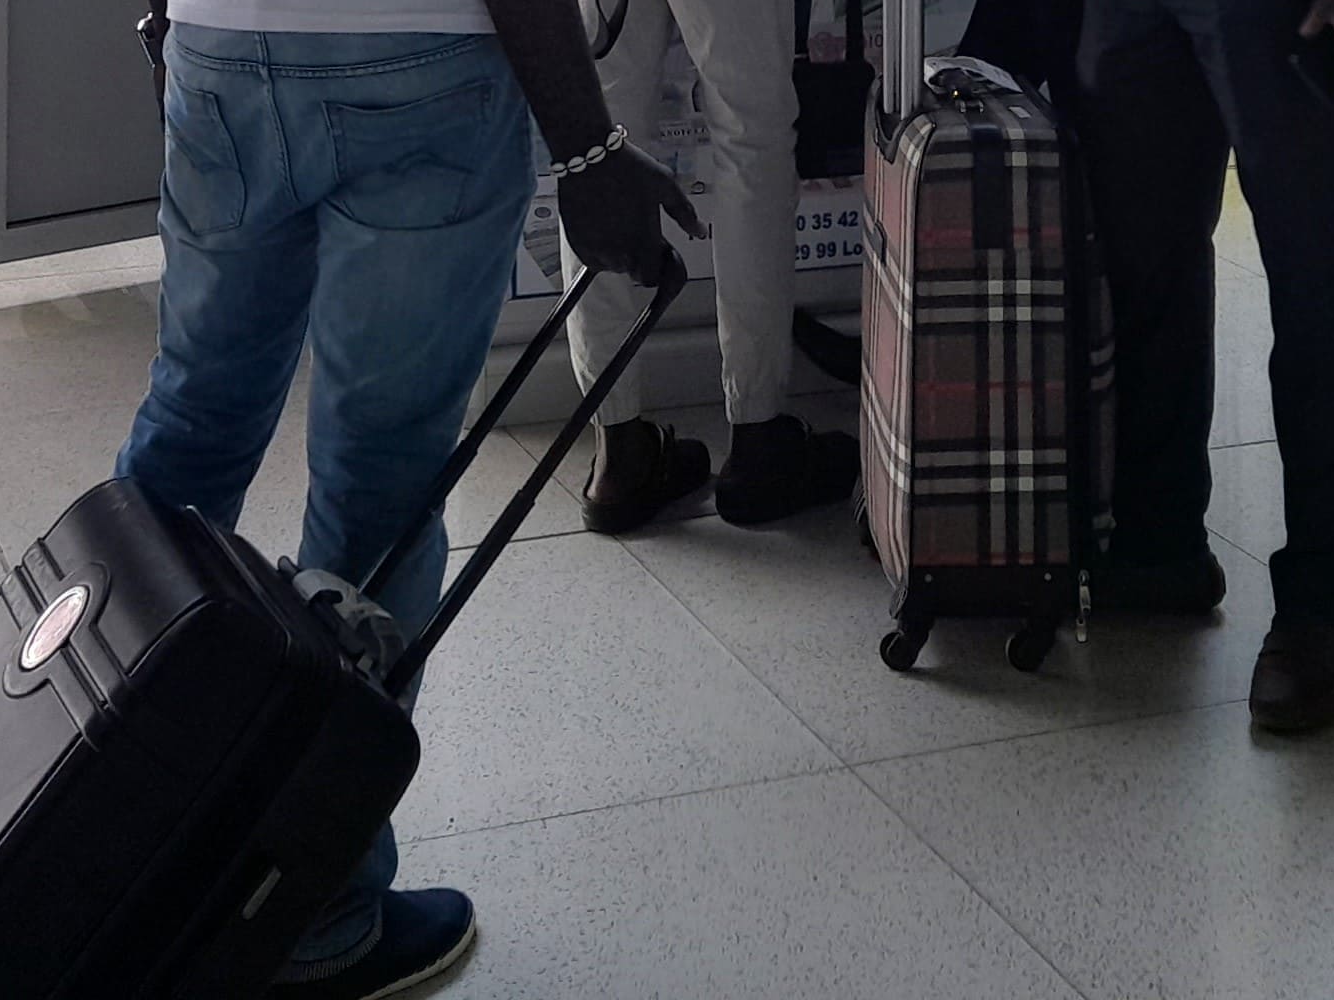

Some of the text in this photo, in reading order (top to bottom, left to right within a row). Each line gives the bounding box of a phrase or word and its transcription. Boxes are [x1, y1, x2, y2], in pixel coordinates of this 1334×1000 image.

[811, 212, 833, 230] 35
[836, 210, 859, 228] 42
[816, 241, 837, 259] 99
